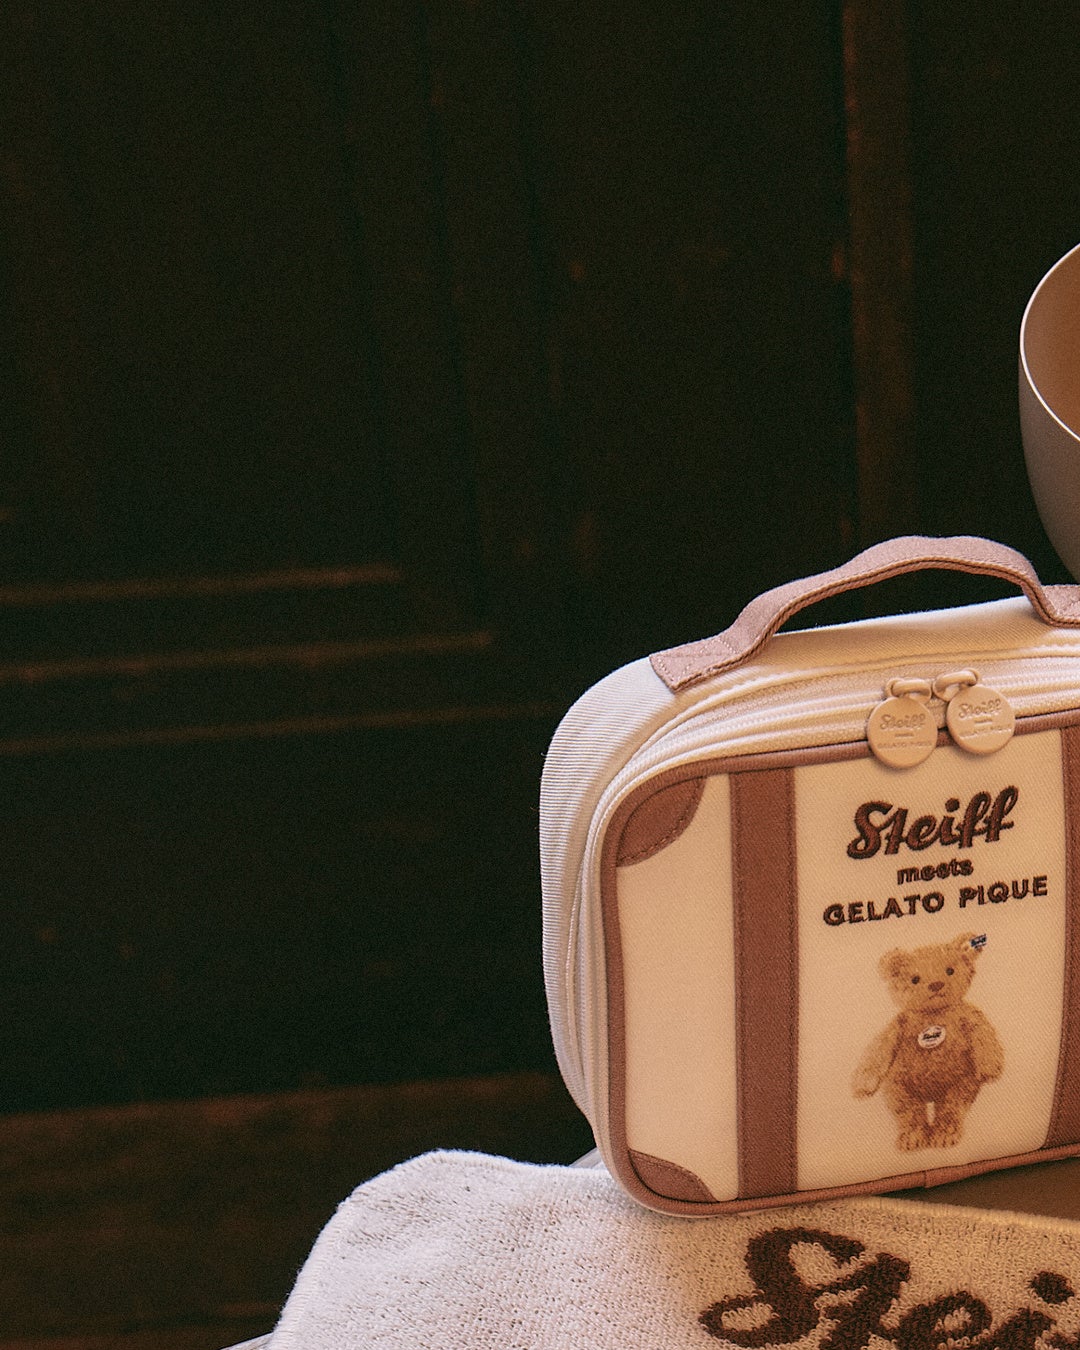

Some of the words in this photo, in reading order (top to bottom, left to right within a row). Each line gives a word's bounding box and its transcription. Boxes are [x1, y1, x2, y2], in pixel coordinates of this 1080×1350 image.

[847, 785, 1019, 859] Steiff
[897, 858, 974, 885] meets
[823, 891, 945, 926] GELATO
[959, 875, 1048, 908] PIQUE
